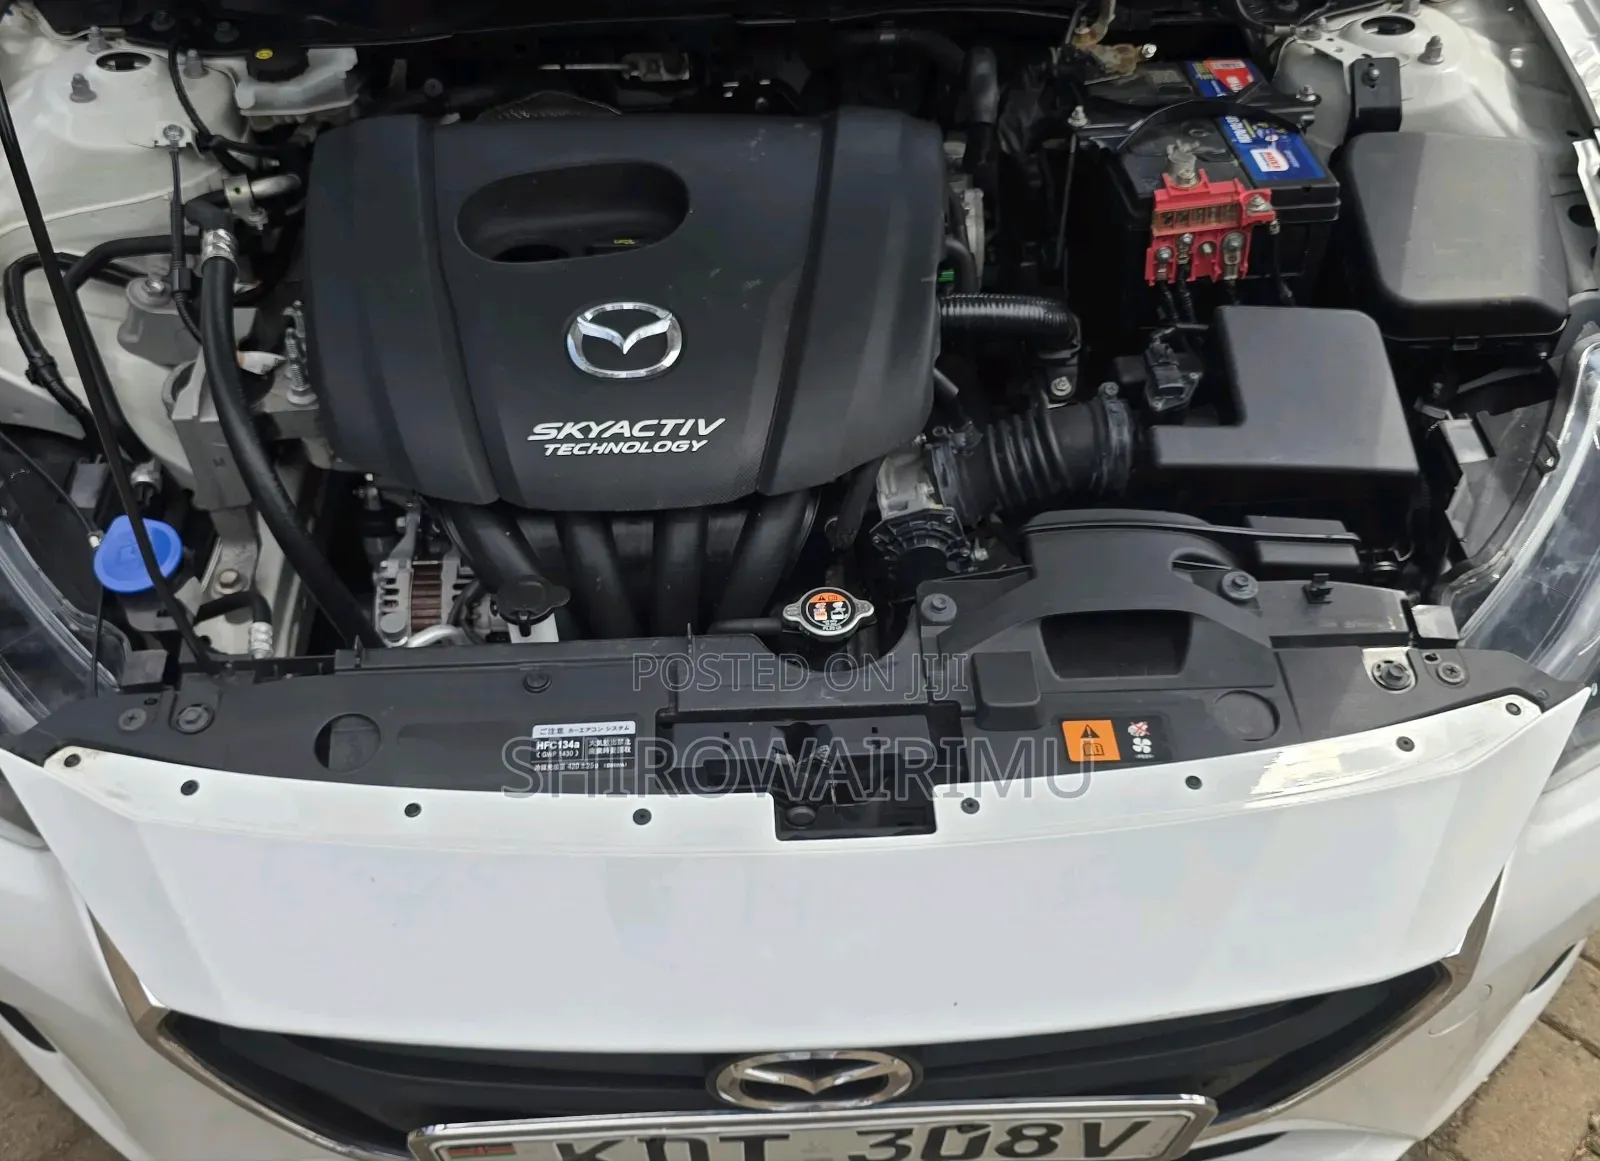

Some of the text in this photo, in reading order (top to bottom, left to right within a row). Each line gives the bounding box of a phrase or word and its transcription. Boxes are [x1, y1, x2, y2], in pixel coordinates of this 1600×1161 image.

[527, 418, 726, 441] SKYACTIV
[544, 439, 708, 456] TECHNOLOGY
[540, 727, 564, 736] ご注意
[536, 740, 580, 750] HFC134a
[848, 1120, 1151, 1161] 308V
